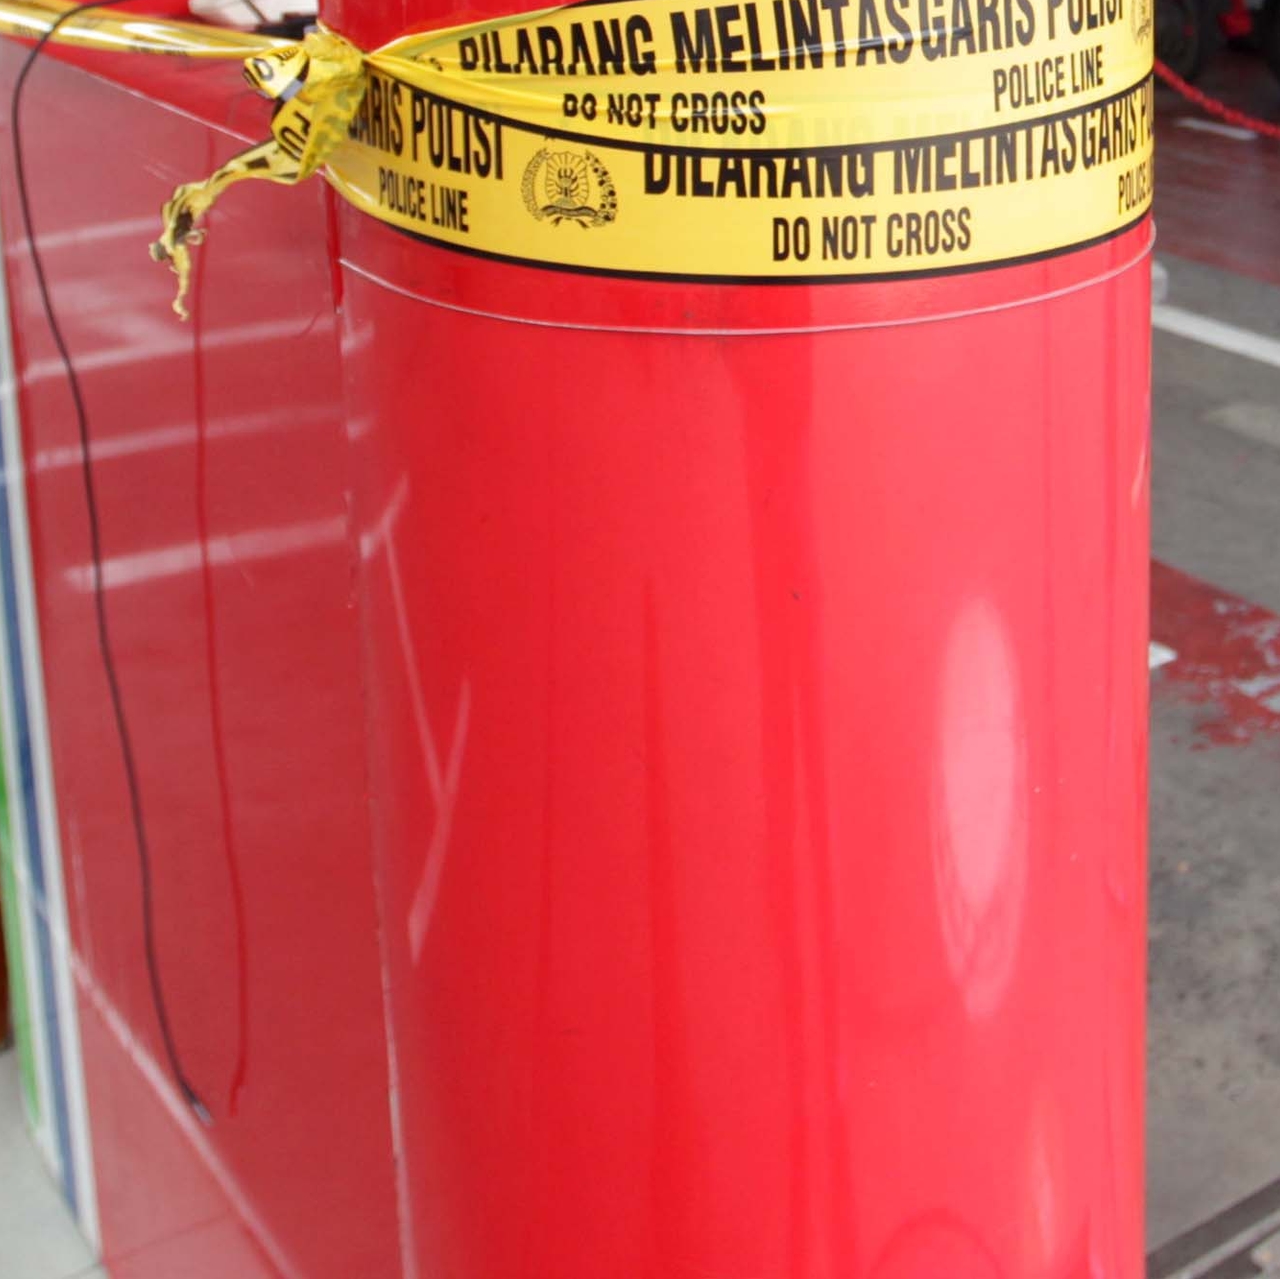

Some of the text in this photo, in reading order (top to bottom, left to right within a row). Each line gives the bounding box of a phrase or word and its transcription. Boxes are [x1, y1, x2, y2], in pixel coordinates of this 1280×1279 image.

[458, 14, 658, 76] DILARANG
[993, 45, 1105, 112] POLICE LINE
[563, 90, 767, 135] DO NOT CROSS
[378, 167, 470, 232] POLICE LINE
[773, 207, 972, 262] DO NOT CROSS
